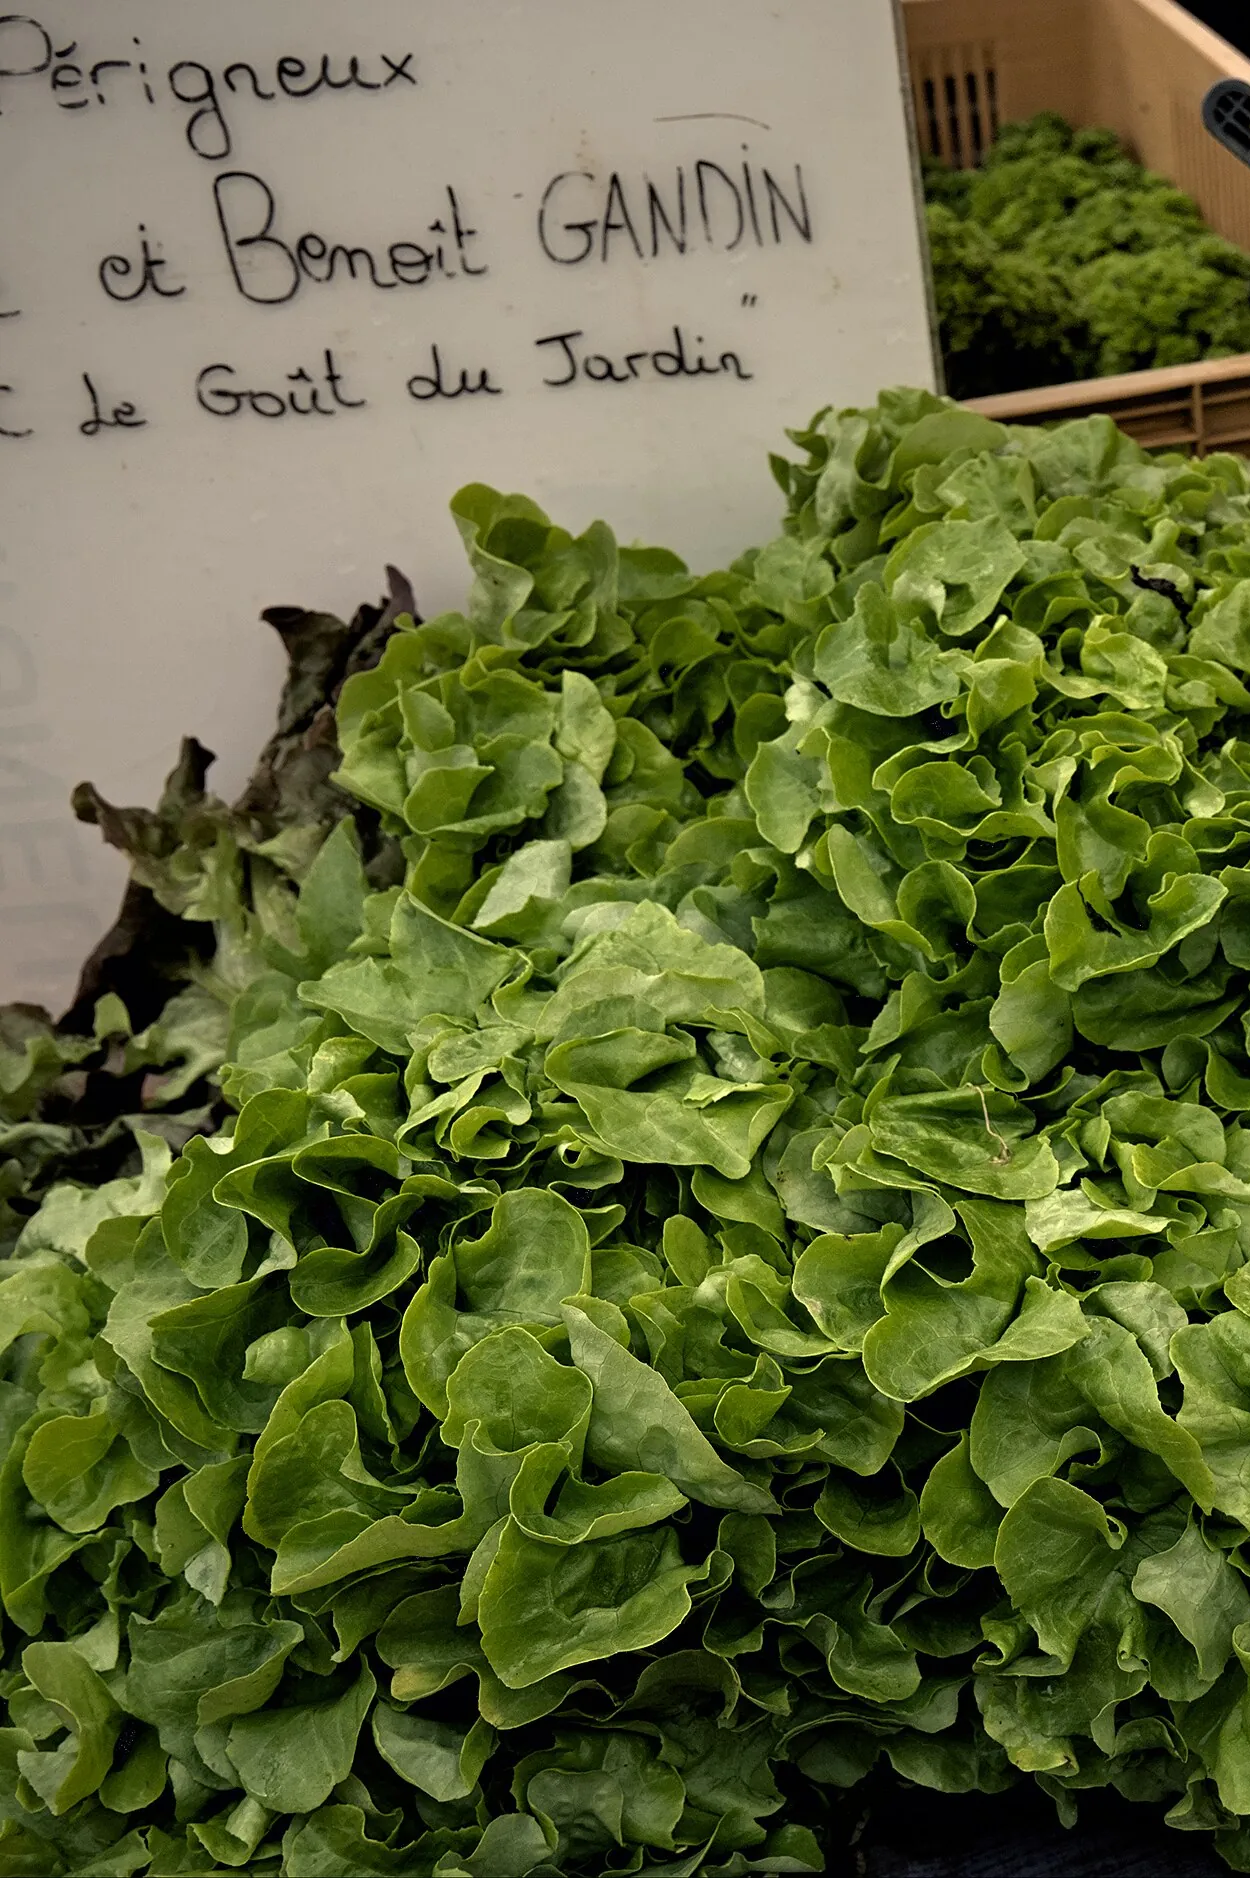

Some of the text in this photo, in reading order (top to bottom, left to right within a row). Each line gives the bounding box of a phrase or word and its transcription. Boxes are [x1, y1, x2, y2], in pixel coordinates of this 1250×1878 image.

[0, 14, 418, 160] Périgneux
[99, 223, 187, 302] et
[212, 170, 490, 304] Benoît
[79, 371, 148, 437] Le
[196, 347, 367, 418] Goût
[406, 343, 503, 401] du
